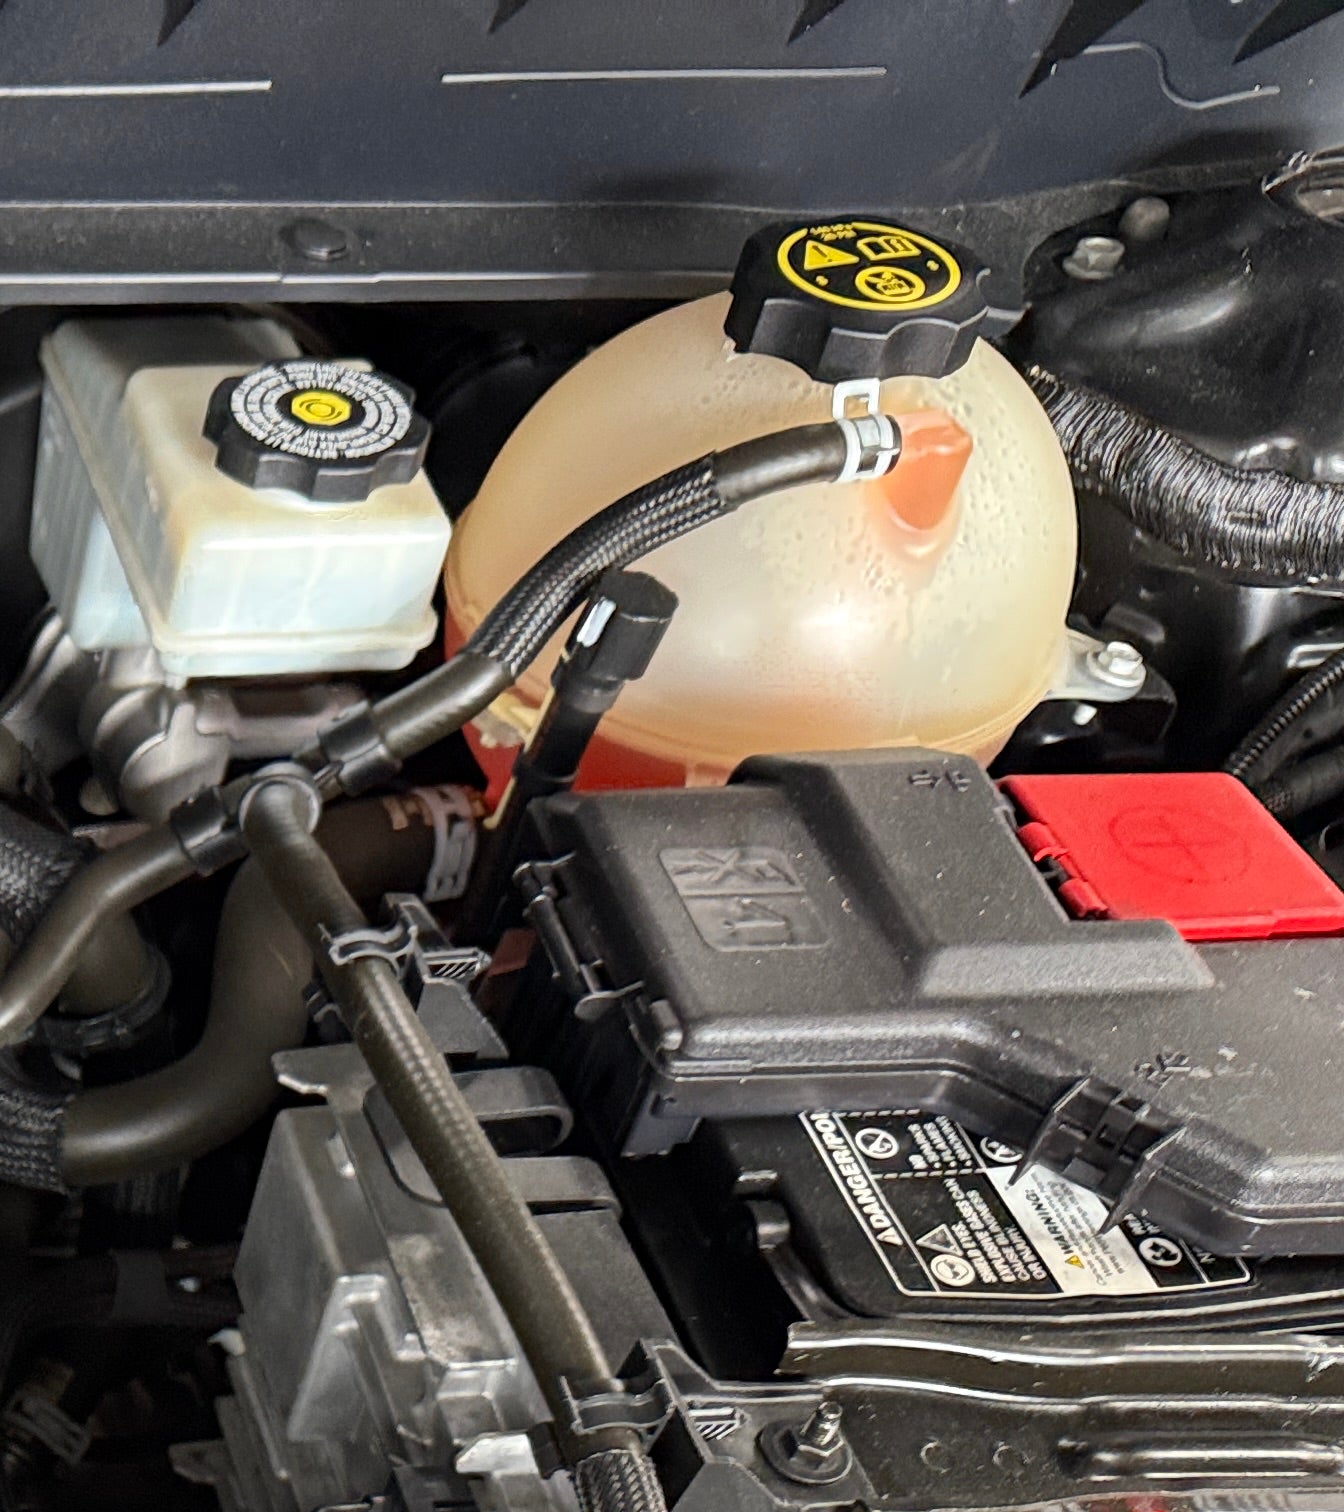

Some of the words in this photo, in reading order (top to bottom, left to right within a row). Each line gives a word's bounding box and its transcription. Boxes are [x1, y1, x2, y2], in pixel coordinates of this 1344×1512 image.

[943, 1178, 964, 1199] CAN
[956, 1200, 983, 1229] GASES
[966, 1190, 1010, 1245] BLINDNESS
[1025, 1190, 1073, 1254] WARNING:
[973, 1230, 1017, 1282] EXPLOSIVE
[1001, 1245, 1031, 1280] CAUSE
[1027, 1262, 1048, 1280] OR
